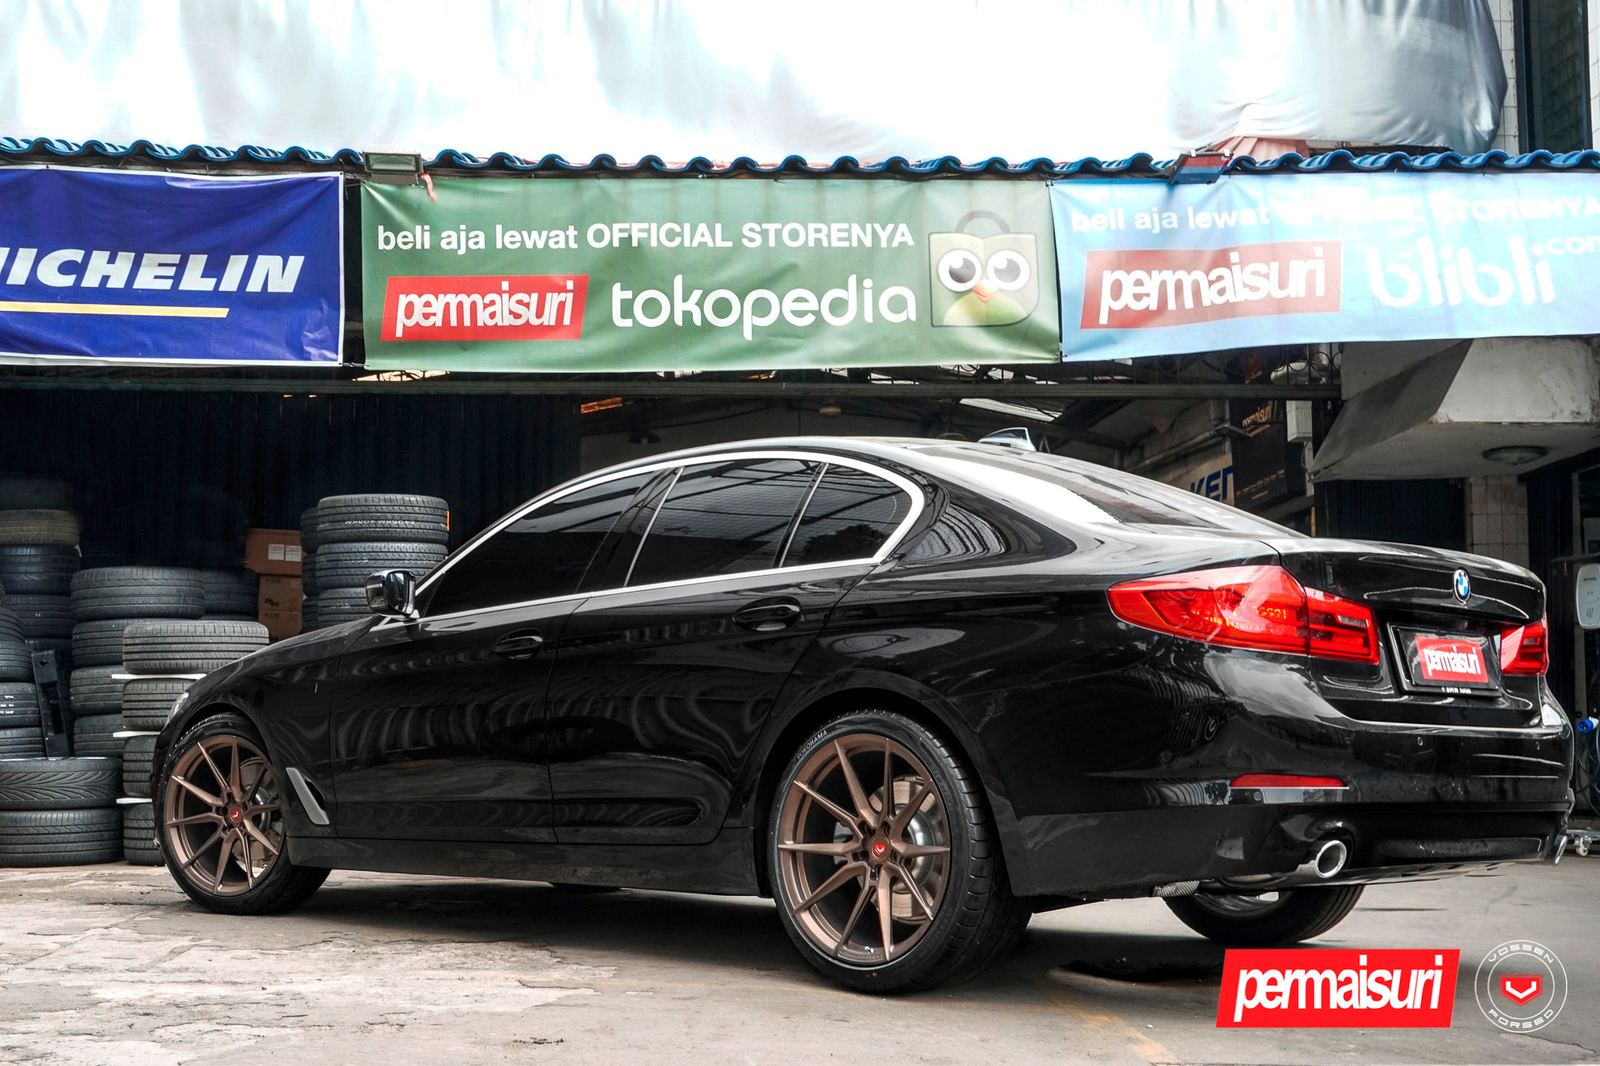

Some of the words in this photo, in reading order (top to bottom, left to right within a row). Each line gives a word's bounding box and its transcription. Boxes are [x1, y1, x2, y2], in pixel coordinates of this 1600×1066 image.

[377, 225, 430, 250] beli
[440, 224, 485, 255] aja
[495, 224, 578, 249] lewat
[586, 222, 733, 248] OFFICIAL
[741, 222, 915, 248] STORENYA
[1134, 207, 1178, 234] aja
[1186, 204, 1270, 229] lewat
[0, 246, 305, 293] ICHELIN
[1098, 246, 1325, 325] permaisuri
[395, 279, 575, 338] permaisuri
[612, 274, 917, 341] tokopedia
[1423, 644, 1481, 677] permaisuri
